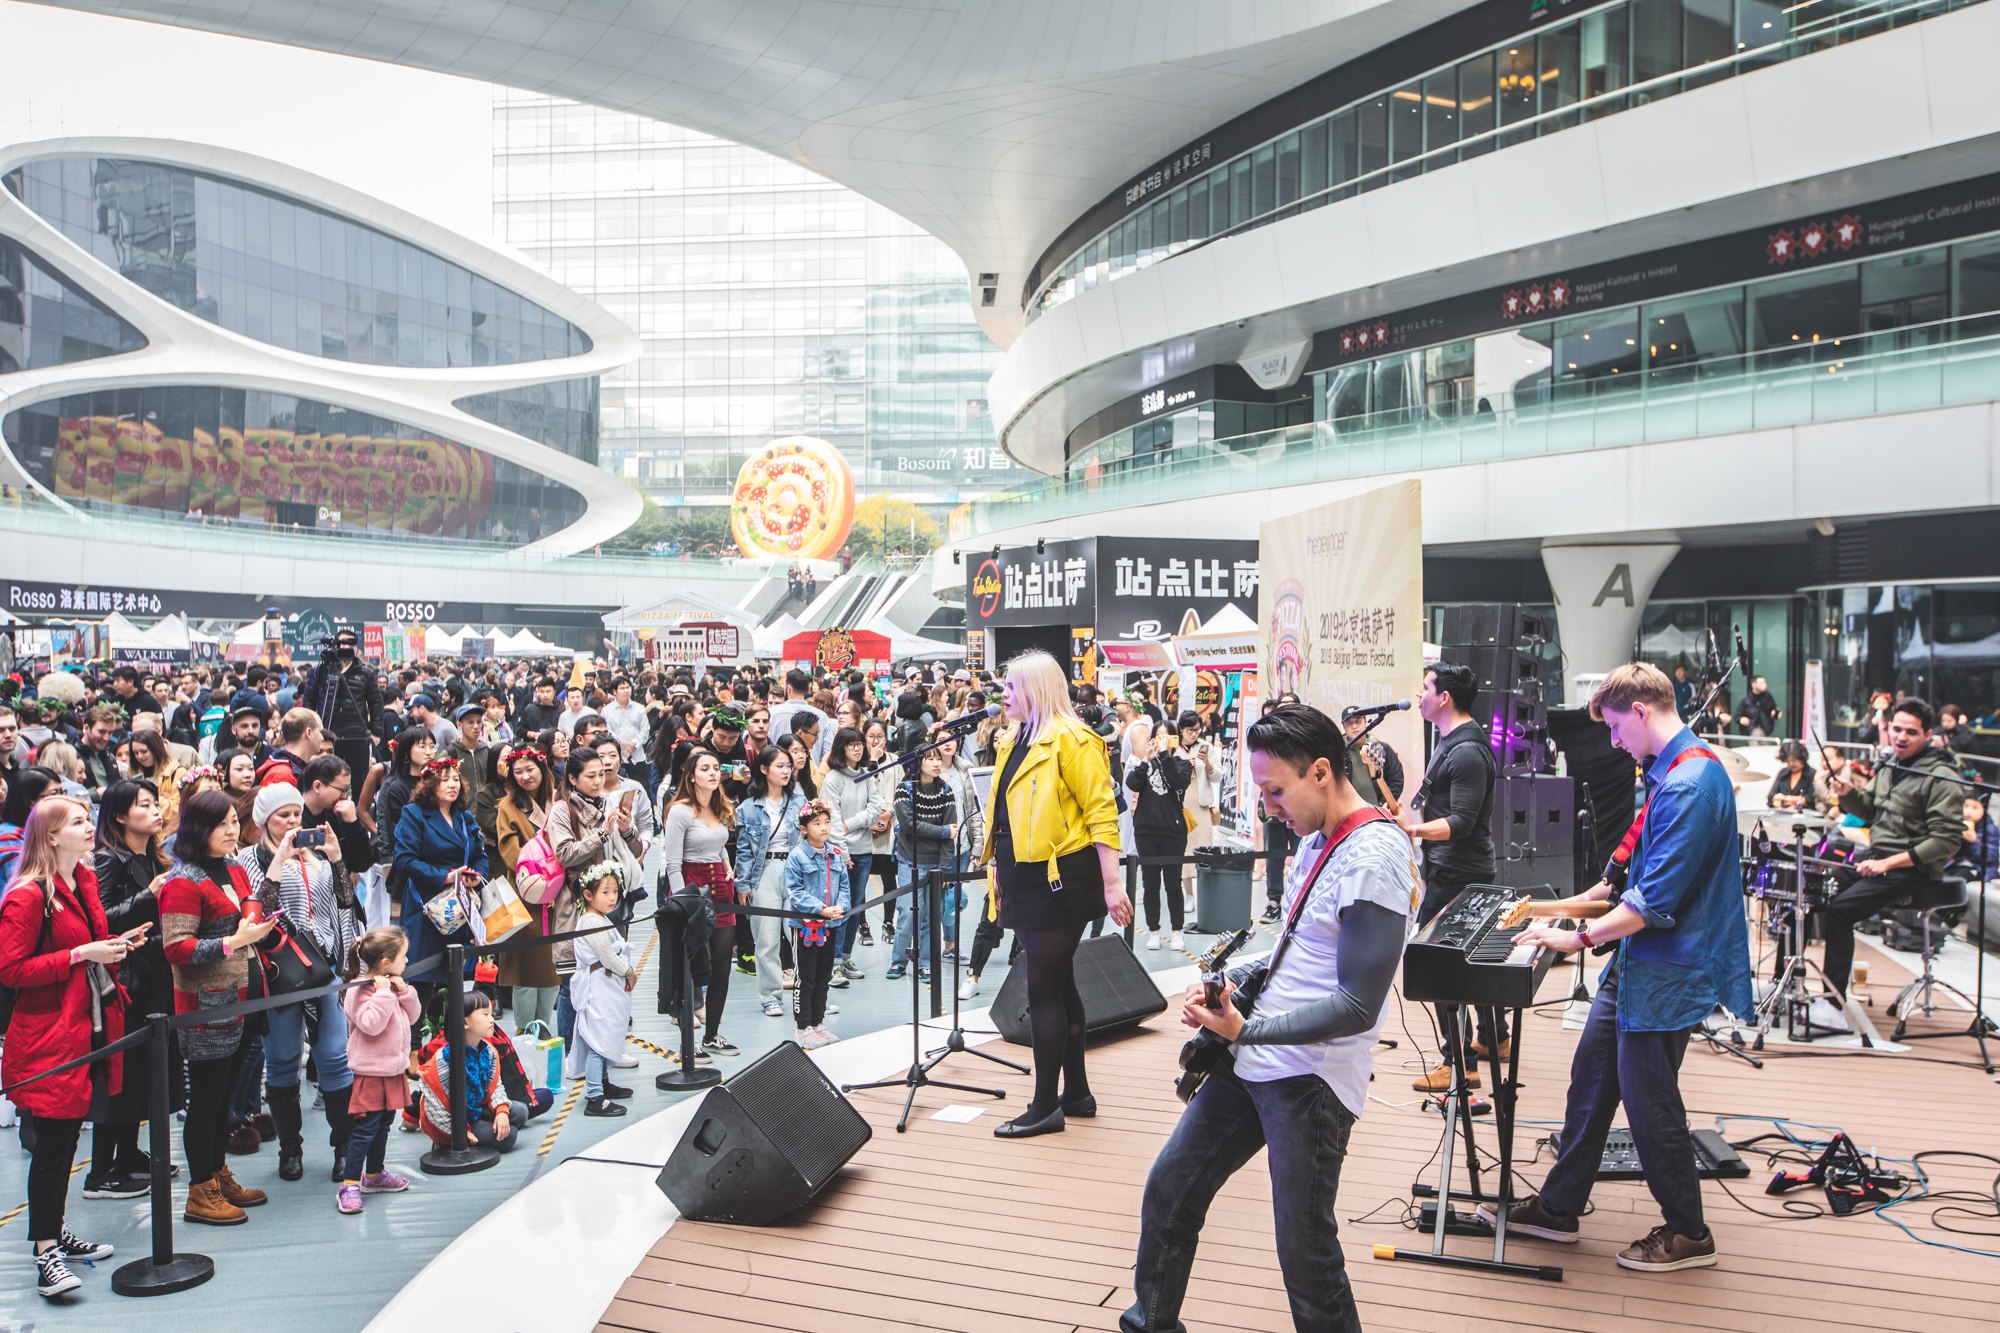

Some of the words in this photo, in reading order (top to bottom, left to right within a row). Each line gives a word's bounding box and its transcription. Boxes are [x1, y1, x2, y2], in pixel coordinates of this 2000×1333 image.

[1868, 213, 1925, 232] Hungarian
[1926, 201, 1972, 220] Cultural
[1868, 230, 1905, 245] Beijing
[1575, 280, 1605, 294] Magyar
[1575, 292, 1604, 304] Peking
[1262, 358, 1279, 371] PLAZA
[1280, 355, 1287, 376] A
[898, 457, 951, 471] Bosom
[1004, 557, 1086, 609] 站点比萨
[1115, 557, 1259, 599] 站点比萨
[1592, 563, 1635, 607] A
[10, 586, 56, 609] Rosso
[386, 603, 436, 620] ROSSO
[641, 611, 671, 620] PIZZA
[673, 611, 715, 620] FETIVAL
[1320, 606, 1395, 645] 2019北京披萨节
[364, 631, 382, 643] IZZA
[125, 650, 174, 660] WALKER
[1210, 646, 1227, 655] Service
[1320, 648, 1332, 664] 2019
[1333, 648, 1350, 669] Beijing
[1352, 648, 1368, 667] Pizza
[1370, 648, 1395, 667] Festival
